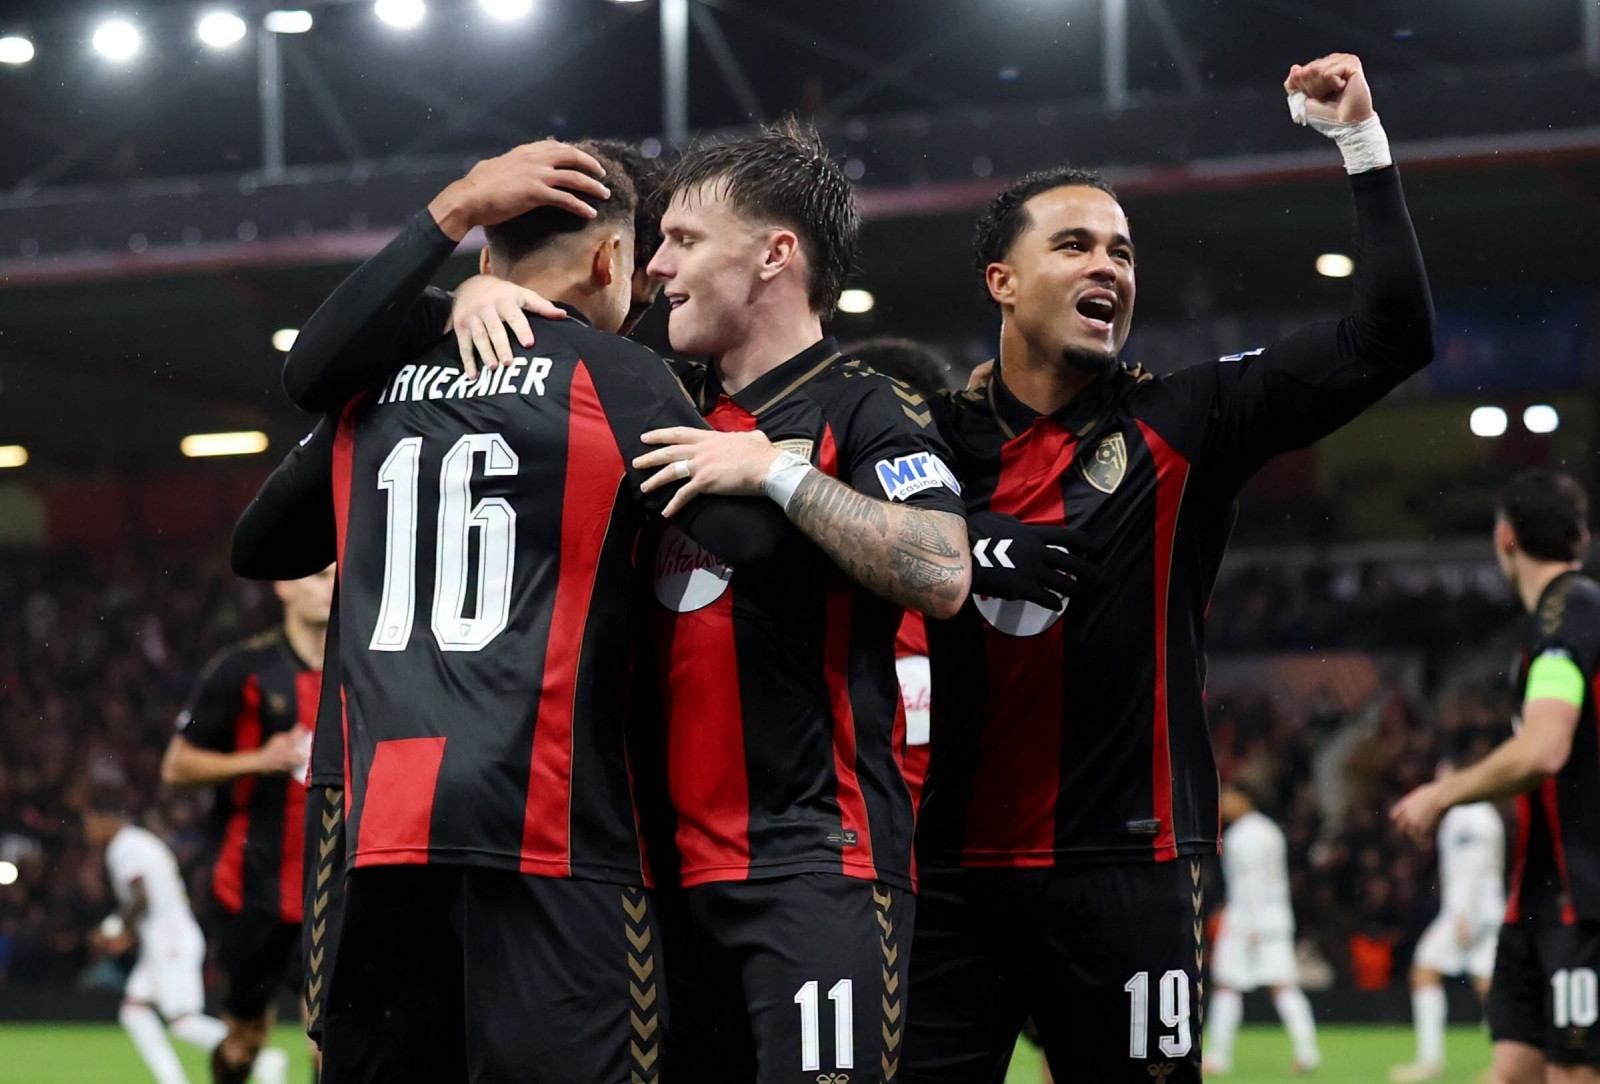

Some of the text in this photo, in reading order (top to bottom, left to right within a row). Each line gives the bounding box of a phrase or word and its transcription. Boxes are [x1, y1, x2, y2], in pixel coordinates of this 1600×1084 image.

[900, 479, 938, 496] casino
[368, 432, 519, 651] 16
[793, 978, 854, 1071] 11
[1124, 969, 1192, 1059] 19
[1550, 966, 1599, 1028] 10
